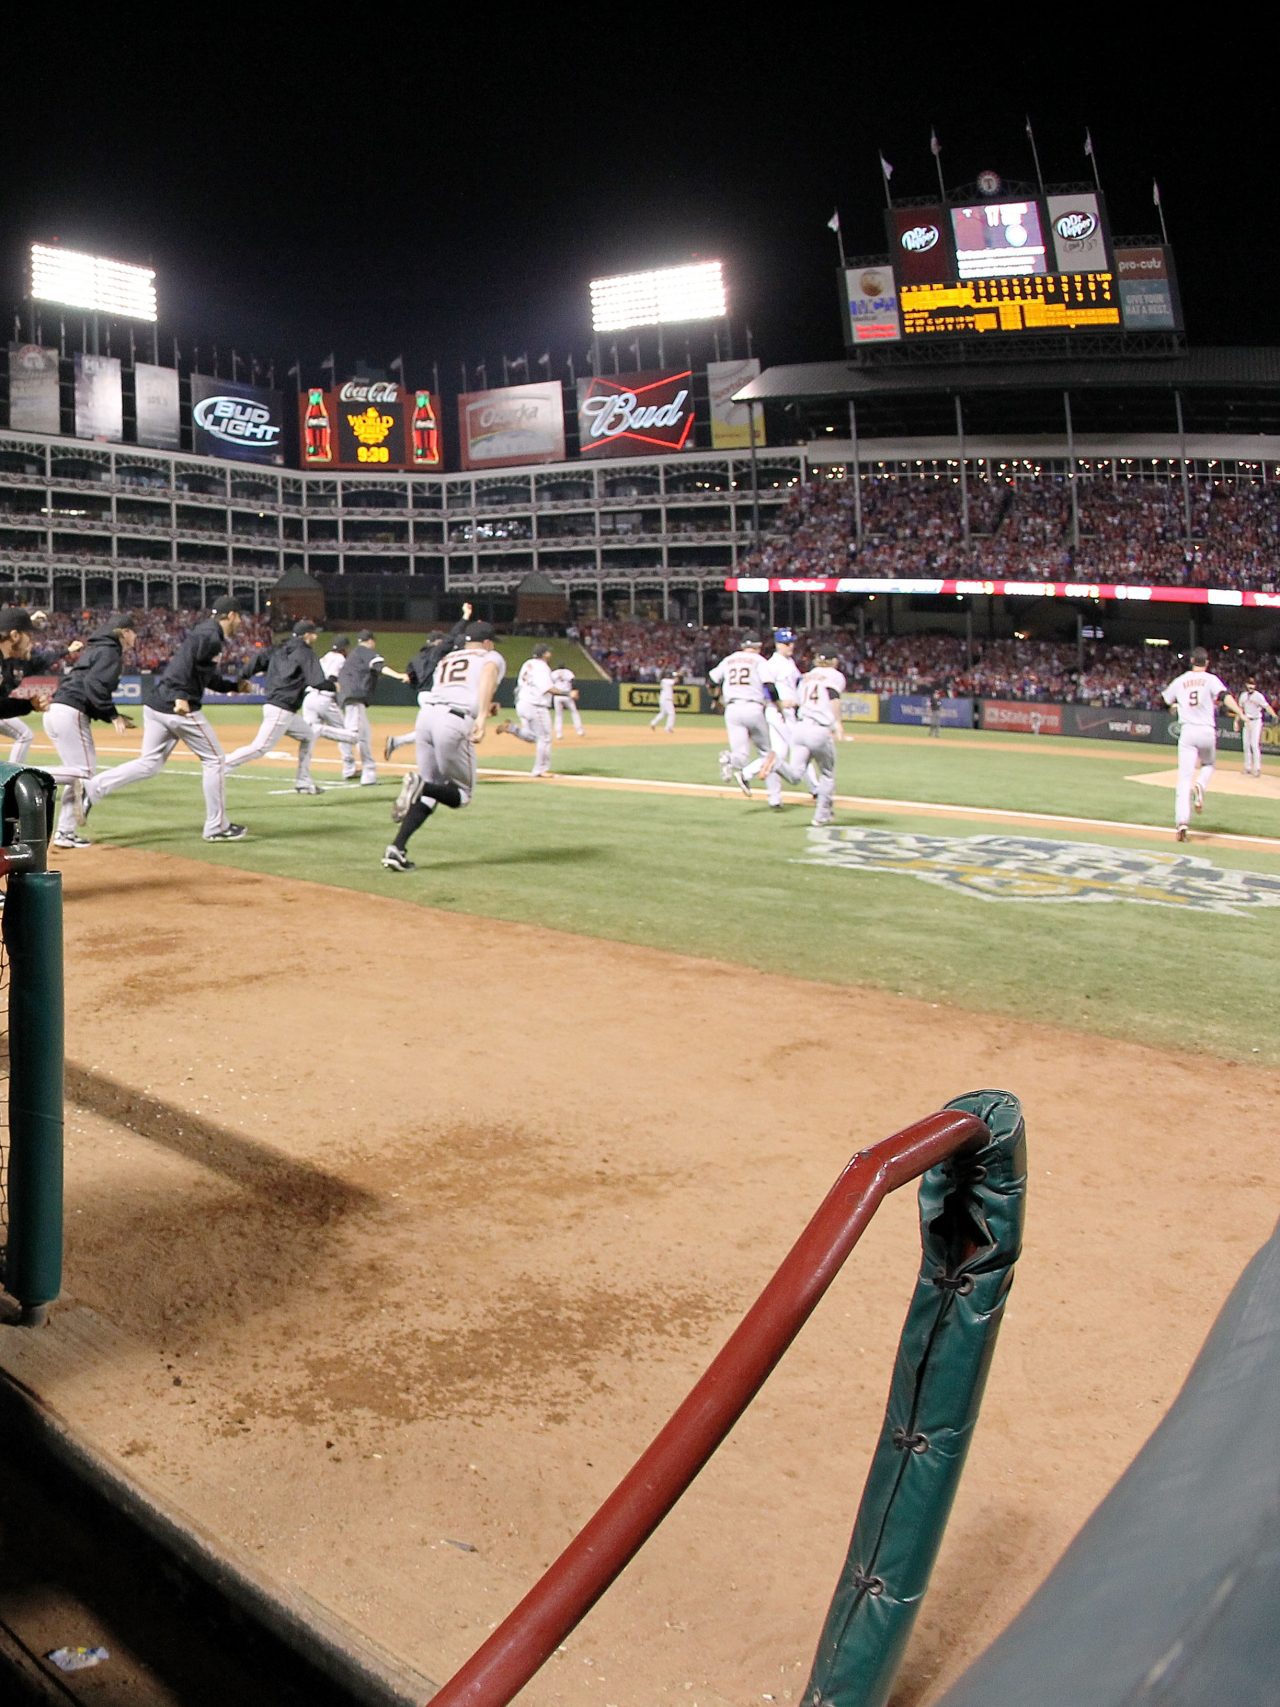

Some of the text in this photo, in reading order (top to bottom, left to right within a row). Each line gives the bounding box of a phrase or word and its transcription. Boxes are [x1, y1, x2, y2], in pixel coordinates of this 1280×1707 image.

[214, 401, 270, 424] BUD
[581, 390, 688, 438] Bud
[204, 414, 280, 440] LIGHT
[439, 659, 470, 683] 12
[729, 668, 750, 686] 22
[804, 684, 819, 705] 14
[1189, 690, 1200, 707] 9
[1109, 719, 1152, 736] verizon
